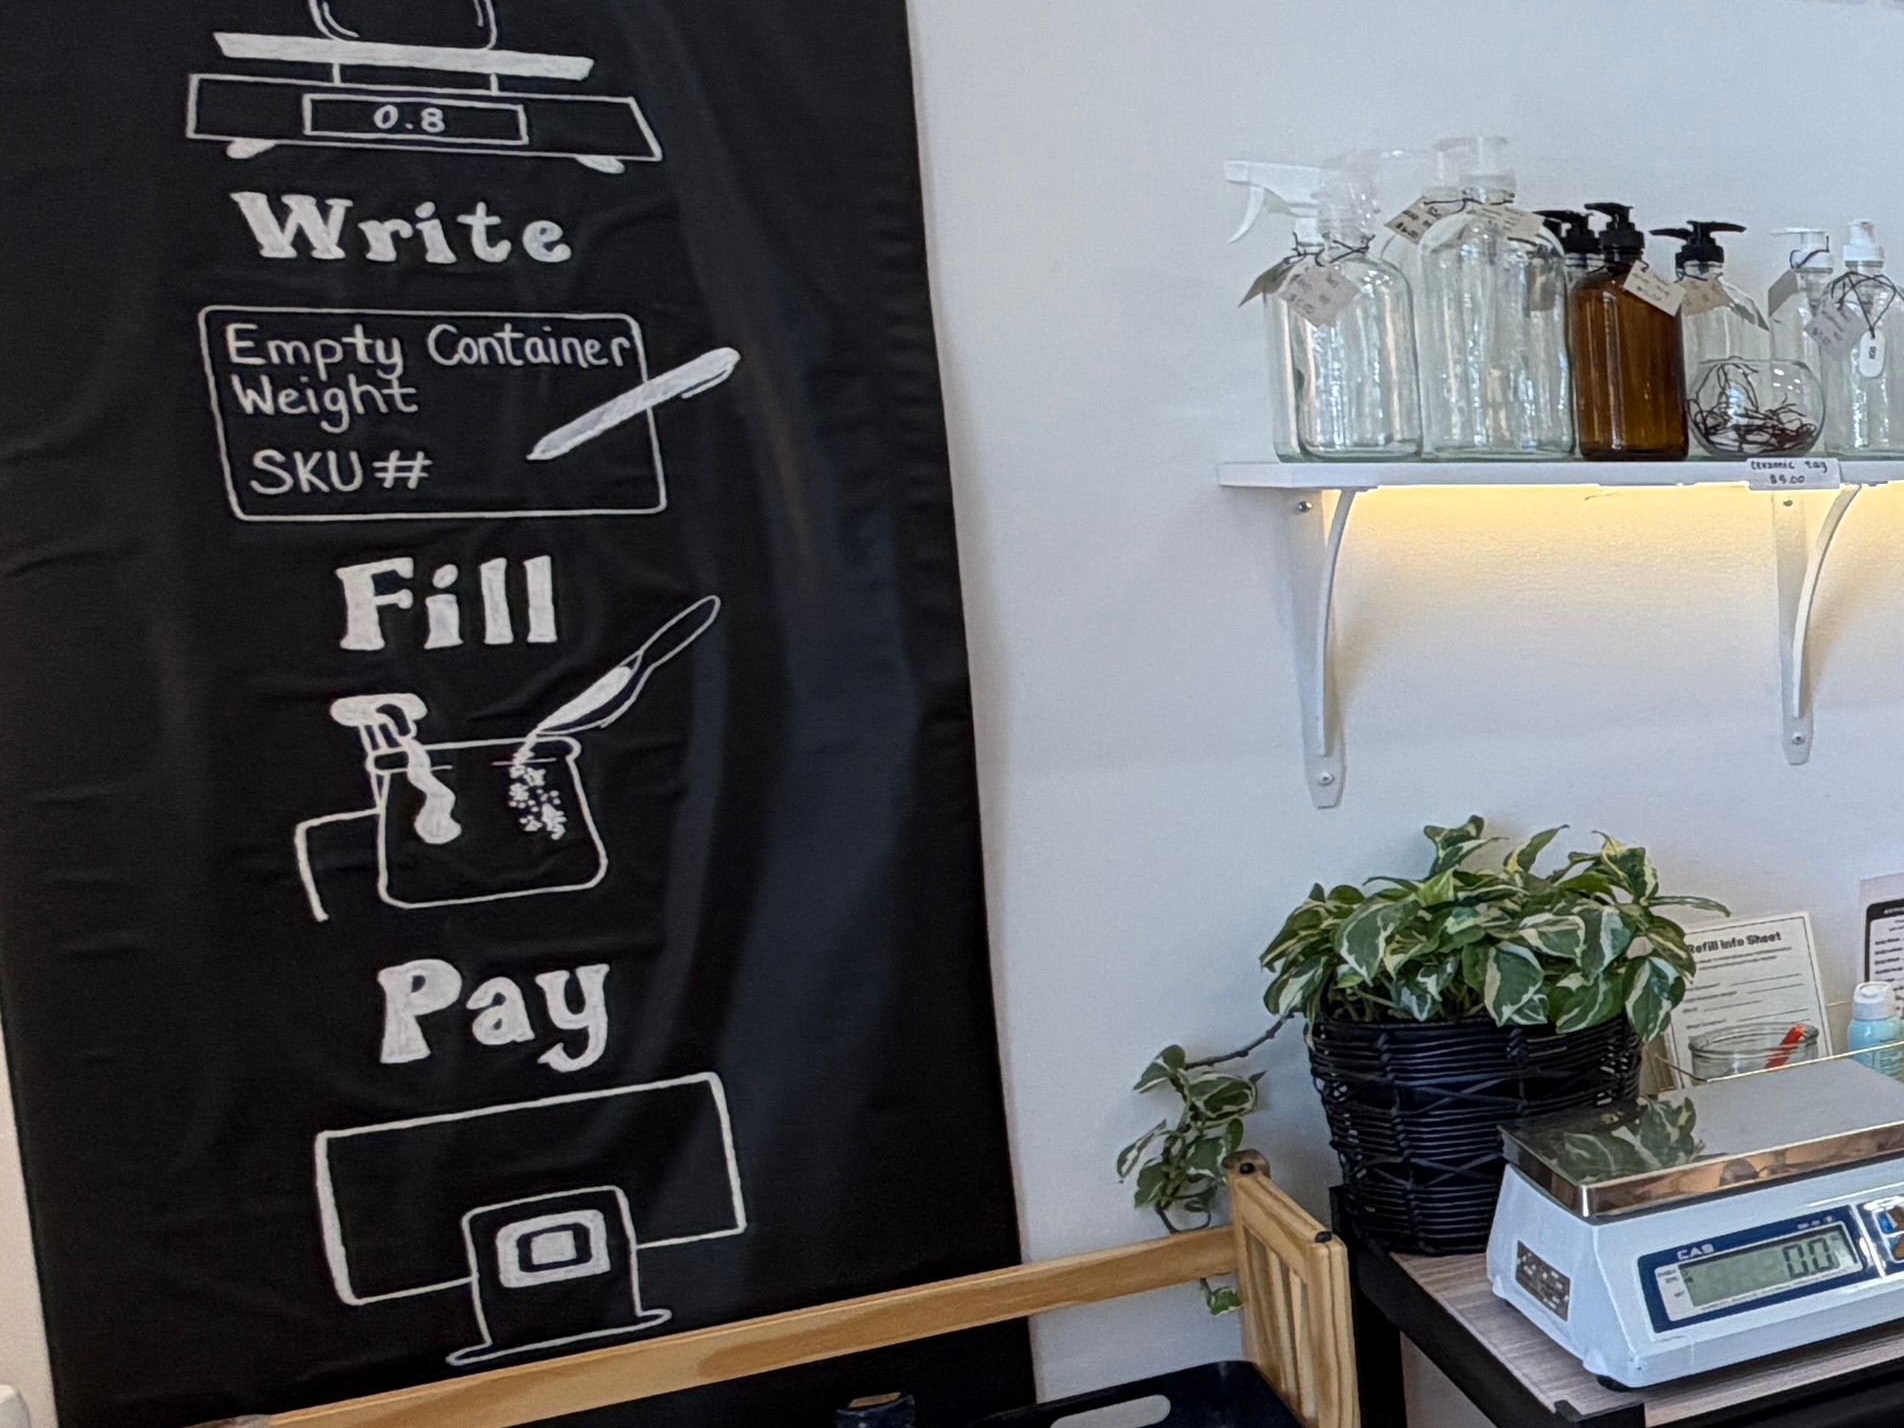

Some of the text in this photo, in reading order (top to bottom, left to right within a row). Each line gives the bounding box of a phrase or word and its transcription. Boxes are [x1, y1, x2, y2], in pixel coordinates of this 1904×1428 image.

[374, 104, 446, 134] 0.8
[231, 191, 572, 263] Write
[226, 325, 632, 397] Empty Container
[232, 373, 420, 433] Weight
[336, 555, 558, 652] Fill
[1721, 938, 1744, 950] Info
[1746, 932, 1781, 946] Sheet
[378, 958, 608, 1072] Pay
